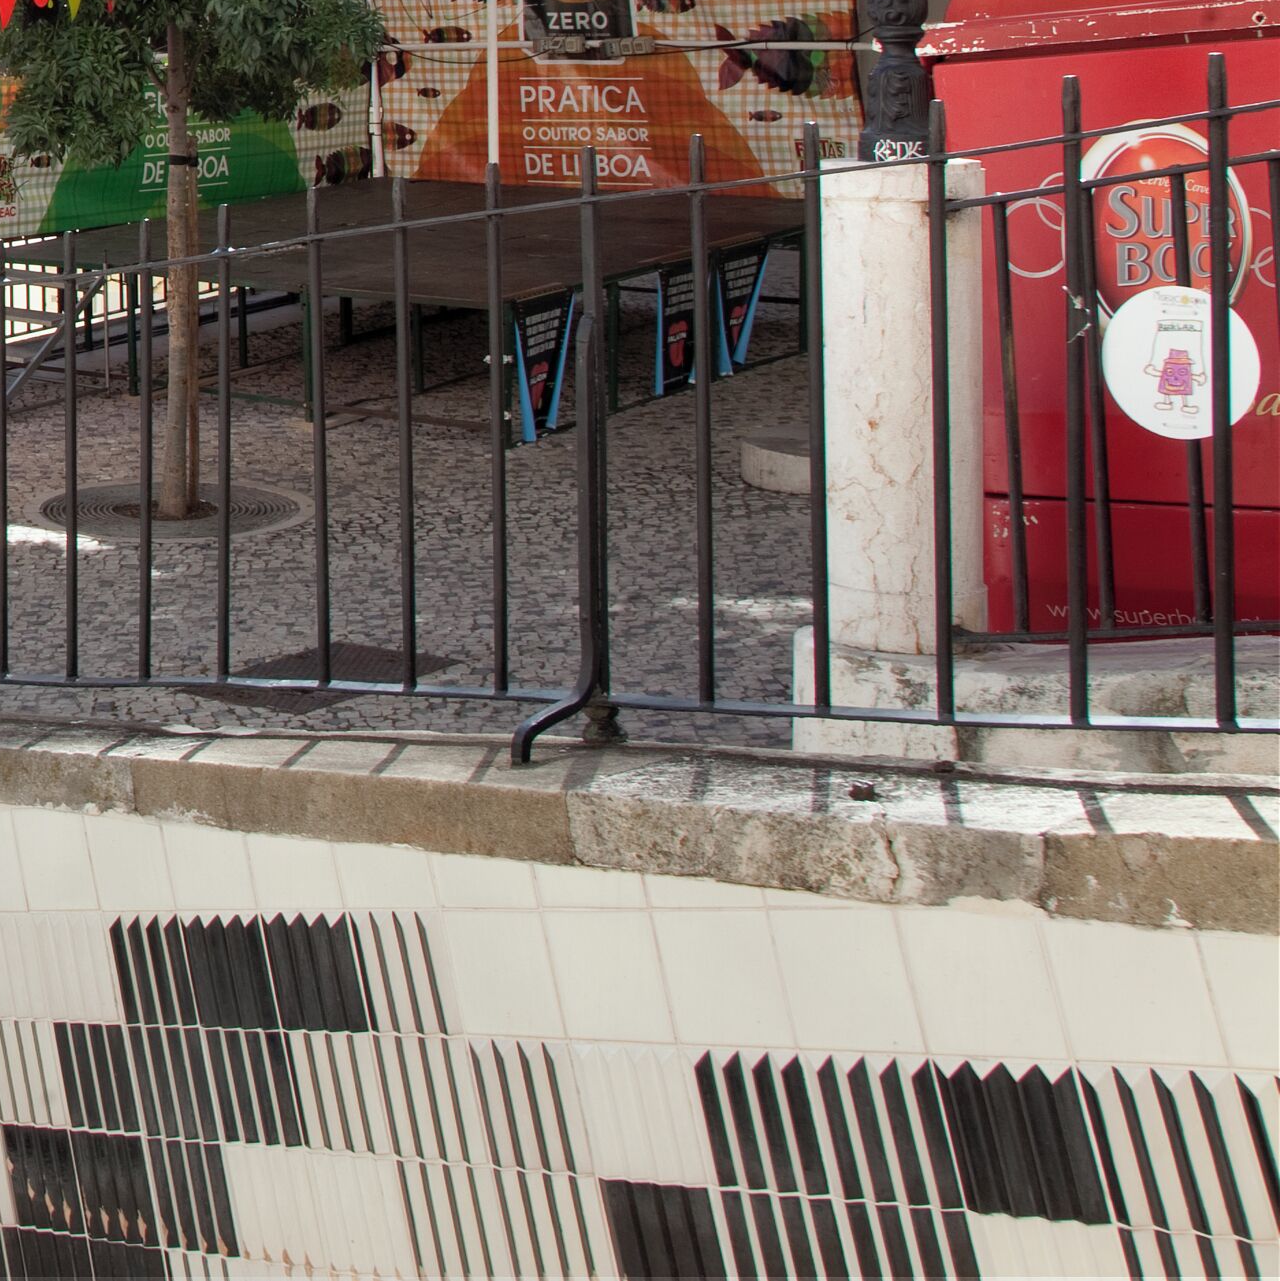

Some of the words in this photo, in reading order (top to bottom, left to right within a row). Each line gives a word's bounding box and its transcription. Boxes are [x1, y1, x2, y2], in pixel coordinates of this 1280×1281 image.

[546, 11, 608, 30] ZERO
[519, 85, 646, 113] PRATICA
[144, 134, 155, 149] O
[523, 127, 535, 141] O
[538, 127, 591, 141] OUTRO
[596, 127, 649, 142] SABOR
[142, 161, 166, 184] DE
[524, 153, 554, 176] DE
[561, 154, 652, 177] LIBOA
